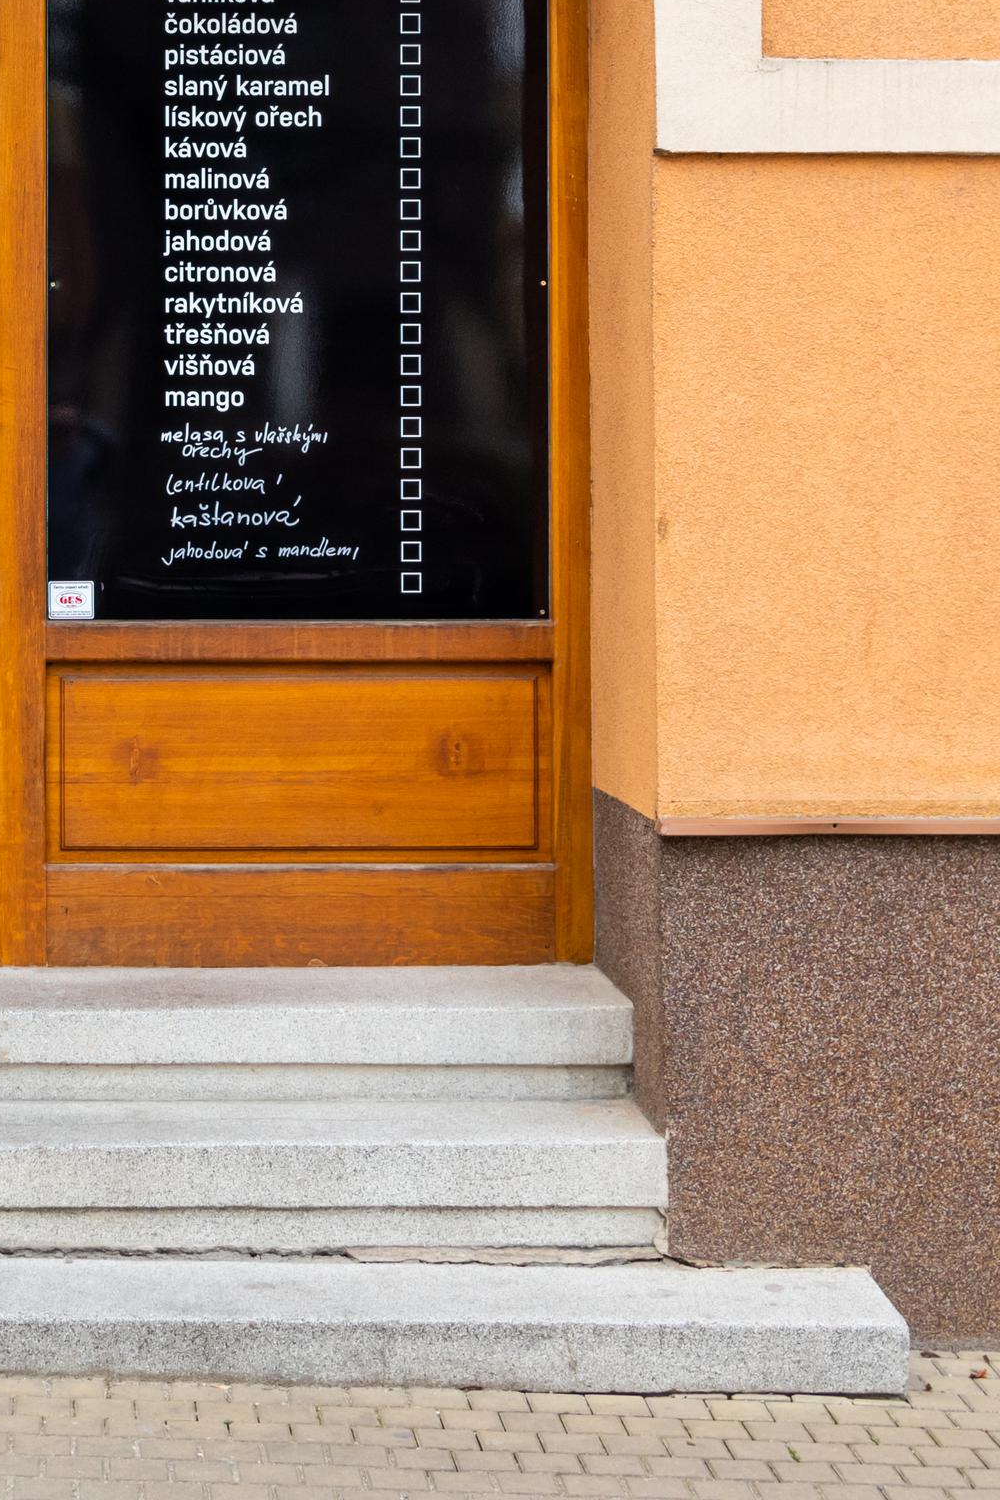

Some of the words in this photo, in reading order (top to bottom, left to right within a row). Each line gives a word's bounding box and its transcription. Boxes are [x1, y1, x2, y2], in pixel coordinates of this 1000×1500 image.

[164, 12, 298, 34] čokoládová
[164, 43, 286, 70] pistáciová
[164, 74, 228, 102] slaný
[236, 74, 330, 98] karamel
[165, 105, 247, 133] lískový
[255, 105, 322, 128] ořech
[165, 136, 247, 159] kávová
[165, 167, 270, 190] malinová
[165, 198, 288, 221] borůvková
[162, 229, 271, 257] jahodová
[164, 260, 277, 283] citronová
[165, 291, 304, 319] rakytníková
[163, 322, 270, 345] třešňová
[163, 353, 255, 376] višňová
[165, 390, 245, 413] mango
[160, 422, 224, 443] melasa
[235, 429, 246, 443] s
[170, 495, 302, 529] kaštanová
[161, 540, 249, 566] jahodová
[255, 545, 269, 559] s
